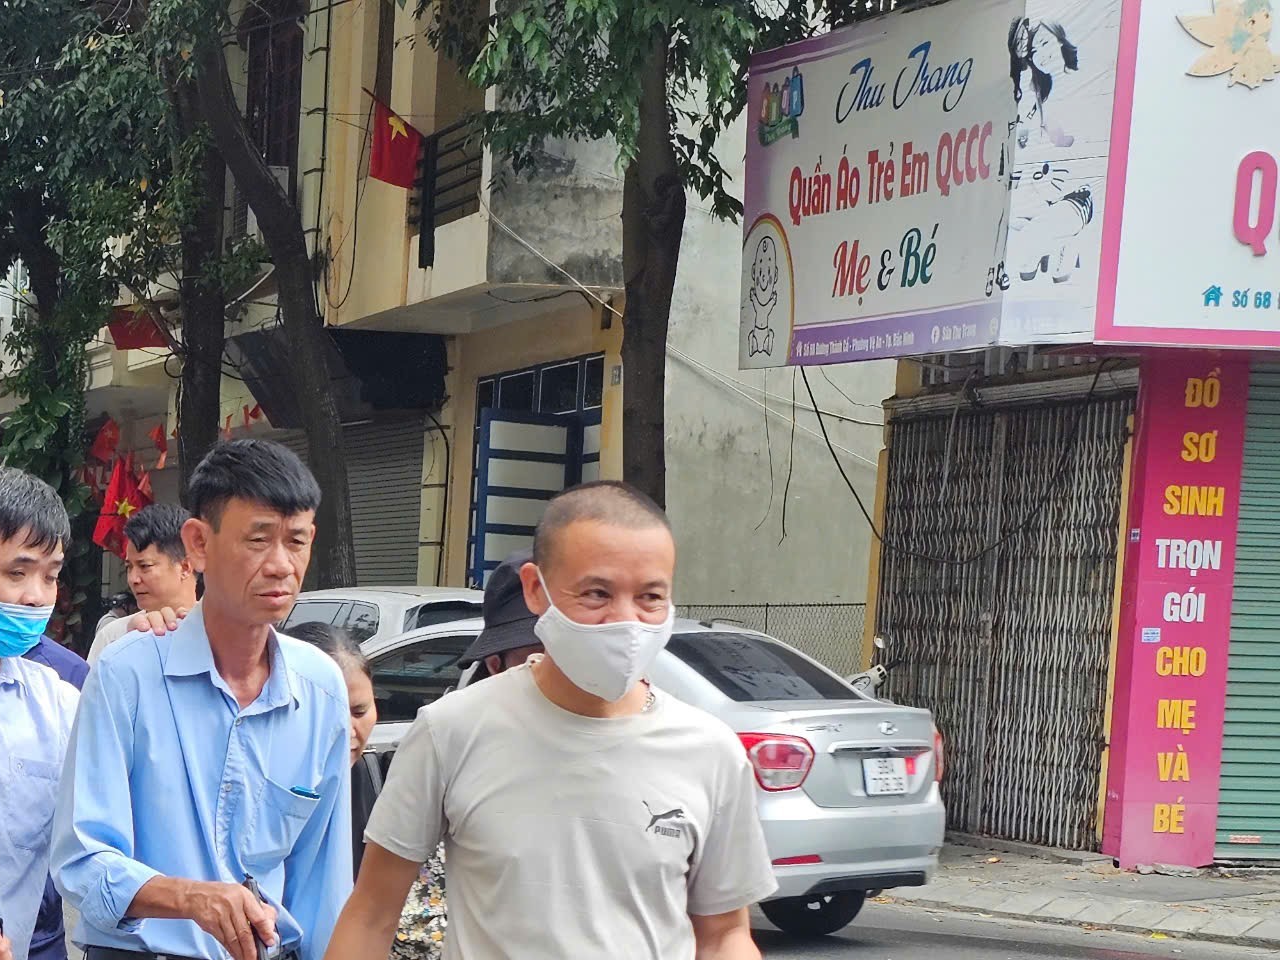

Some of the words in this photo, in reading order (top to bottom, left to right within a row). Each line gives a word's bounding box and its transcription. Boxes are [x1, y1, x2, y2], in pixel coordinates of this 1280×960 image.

[836, 57, 886, 124] Thu
[893, 40, 974, 113] Trang
[836, 143, 861, 212] Áo
[867, 141, 895, 205] Trẻ
[900, 141, 930, 198] Em
[935, 120, 993, 197] QCCC
[832, 239, 871, 306] Mẹ
[877, 249, 896, 292] &
[899, 223, 940, 288] Bé
[1231, 287, 1251, 308] Số
[1254, 290, 1272, 309] 68
[1184, 367, 1222, 408] ĐỒ
[1181, 429, 1218, 463] SƠ
[1163, 484, 1225, 517] SINH
[1155, 538, 1222, 577] TRỌN
[1162, 586, 1206, 623] GÓI
[1156, 646, 1207, 677] CHO
[1157, 699, 1197, 735] MẸ
[1157, 743, 1190, 782] VÀ
[1153, 796, 1185, 834] BÉ
